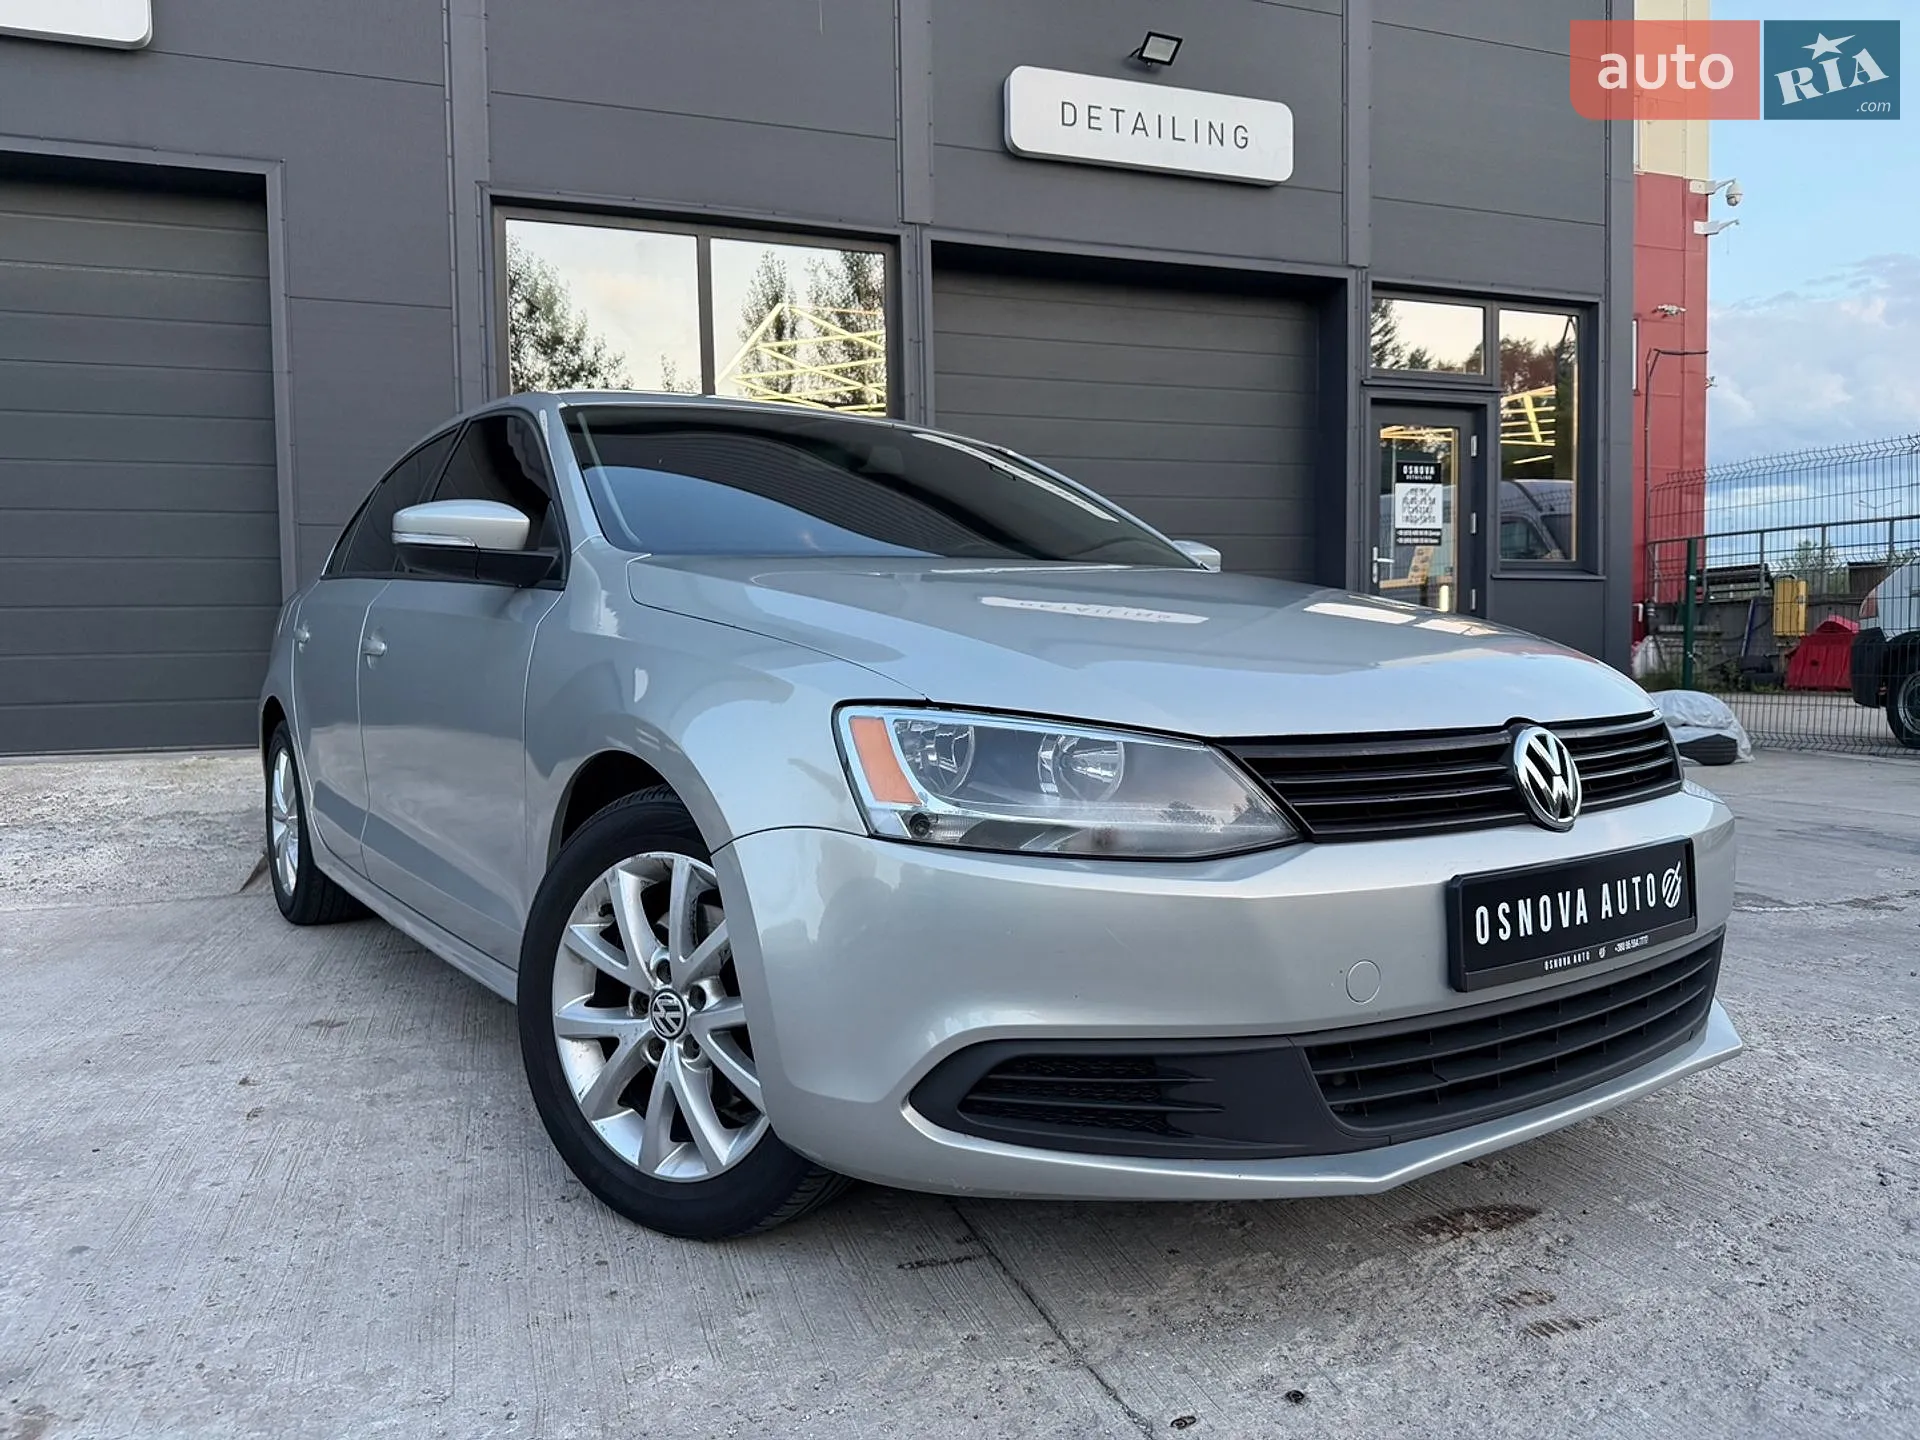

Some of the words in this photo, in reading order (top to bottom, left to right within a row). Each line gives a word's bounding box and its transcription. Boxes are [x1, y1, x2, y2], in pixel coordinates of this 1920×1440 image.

[1060, 101, 1249, 149] DETAILING
[1475, 888, 1588, 945] OSNOVA
[1600, 872, 1656, 920] AUTO
